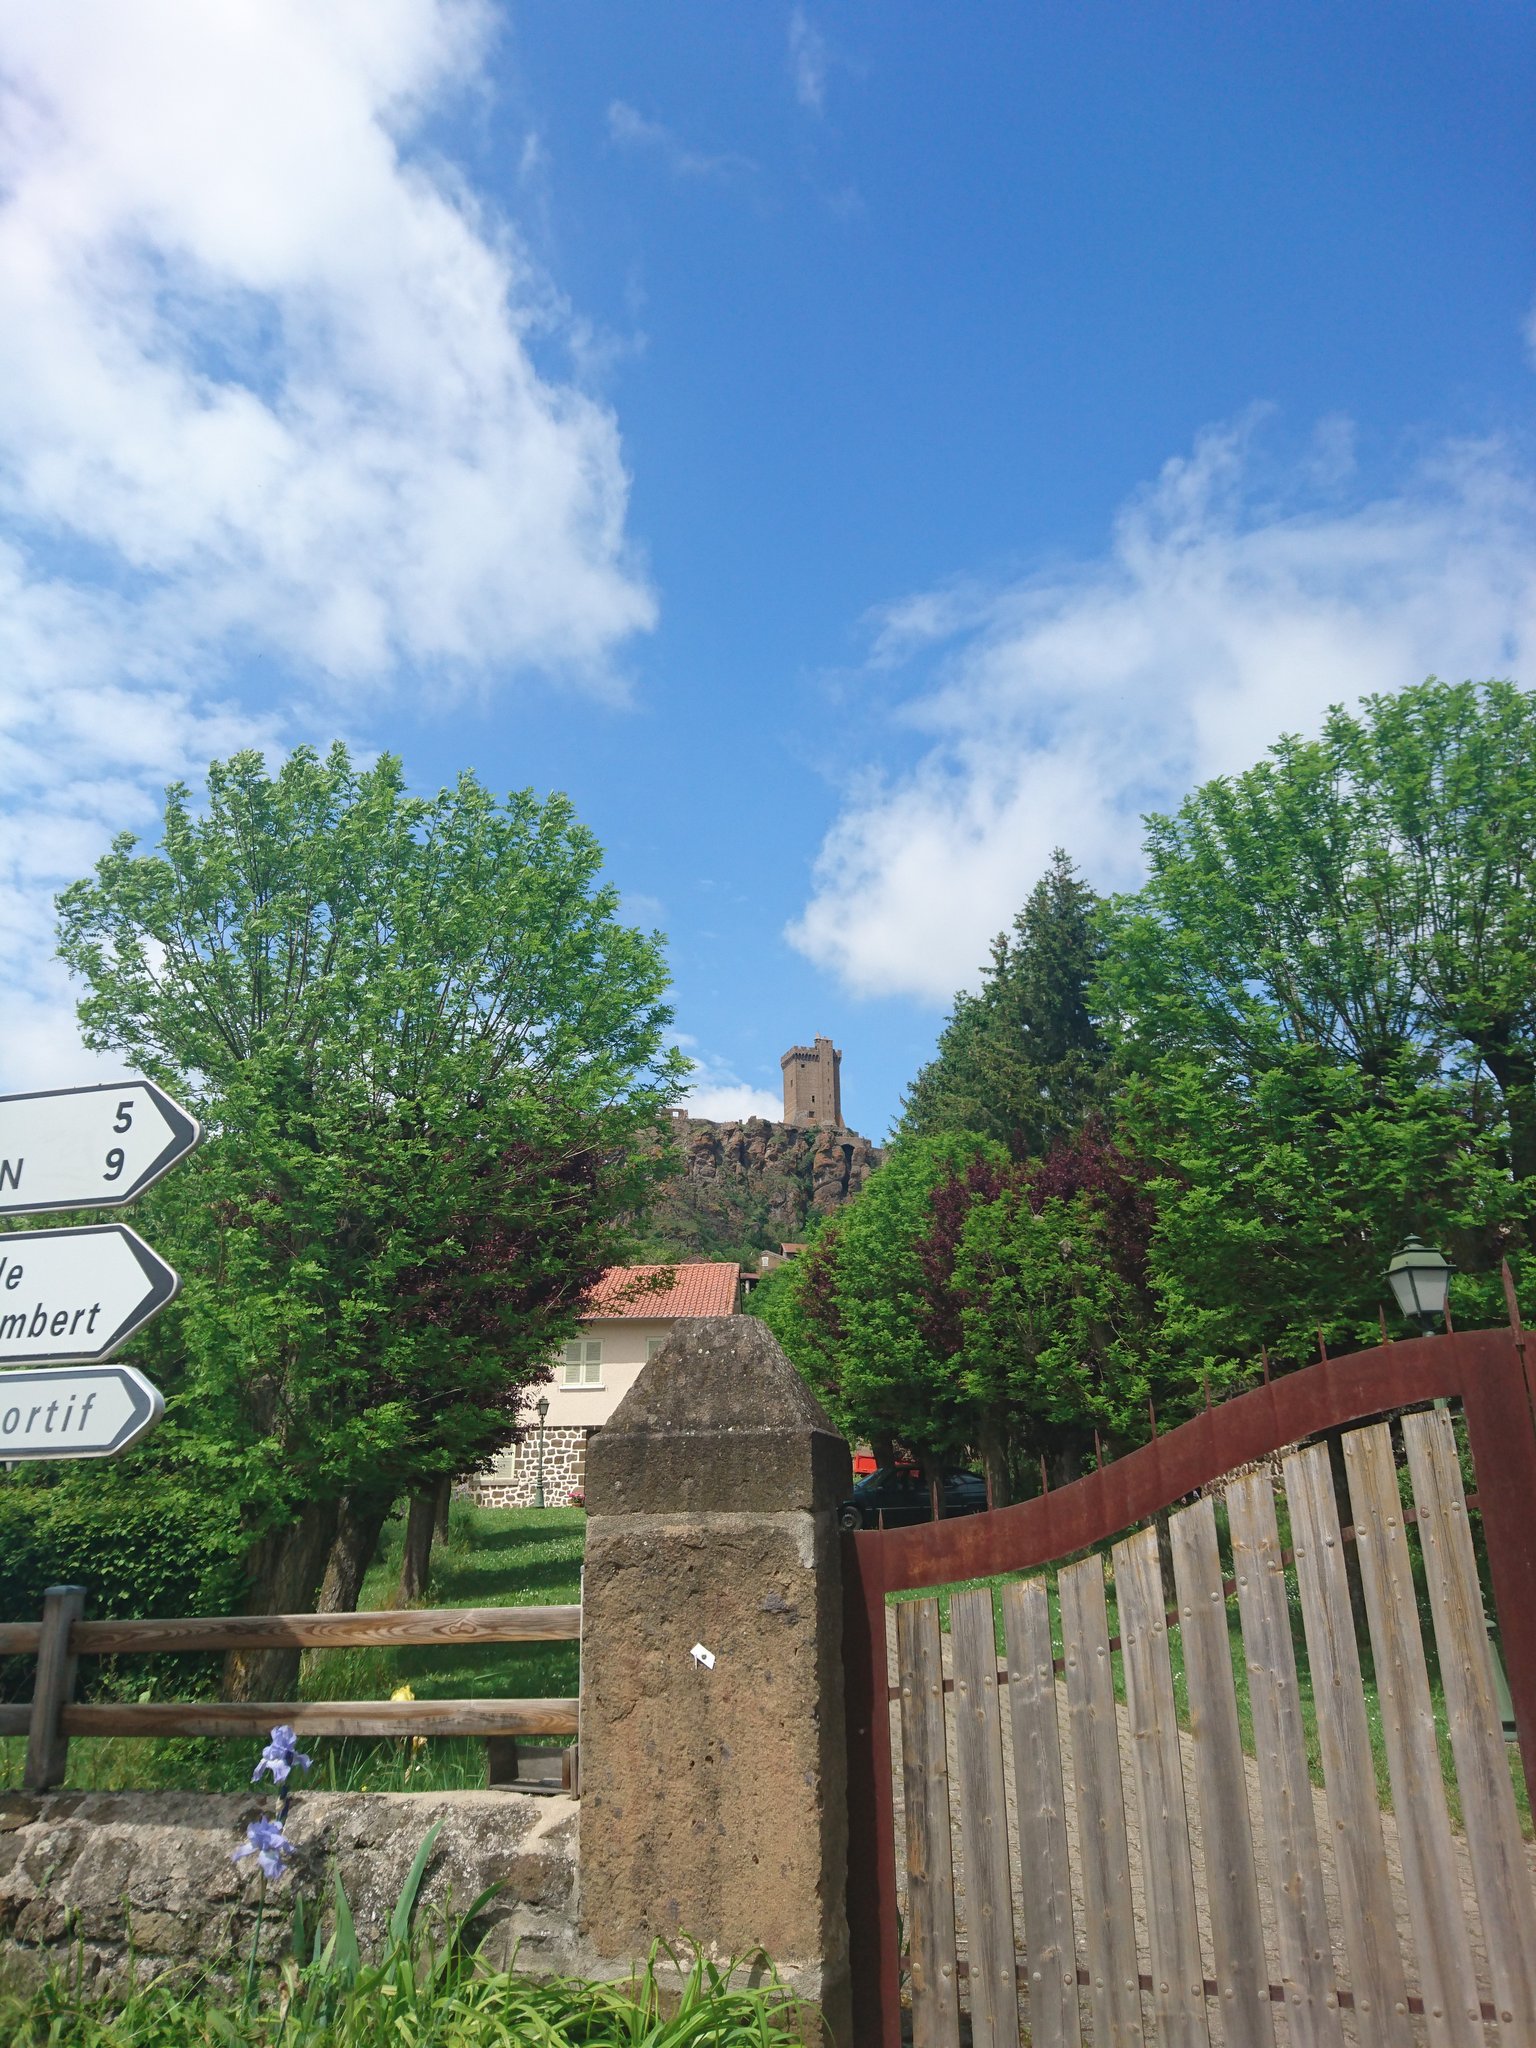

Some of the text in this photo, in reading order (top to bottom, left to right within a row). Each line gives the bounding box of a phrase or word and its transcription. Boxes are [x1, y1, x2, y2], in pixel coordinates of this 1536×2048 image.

[112, 1101, 134, 1133] 5
[0, 1147, 125, 1191] N 9
[0, 1302, 101, 1339] mbert
[2, 1392, 97, 1435] ortif
